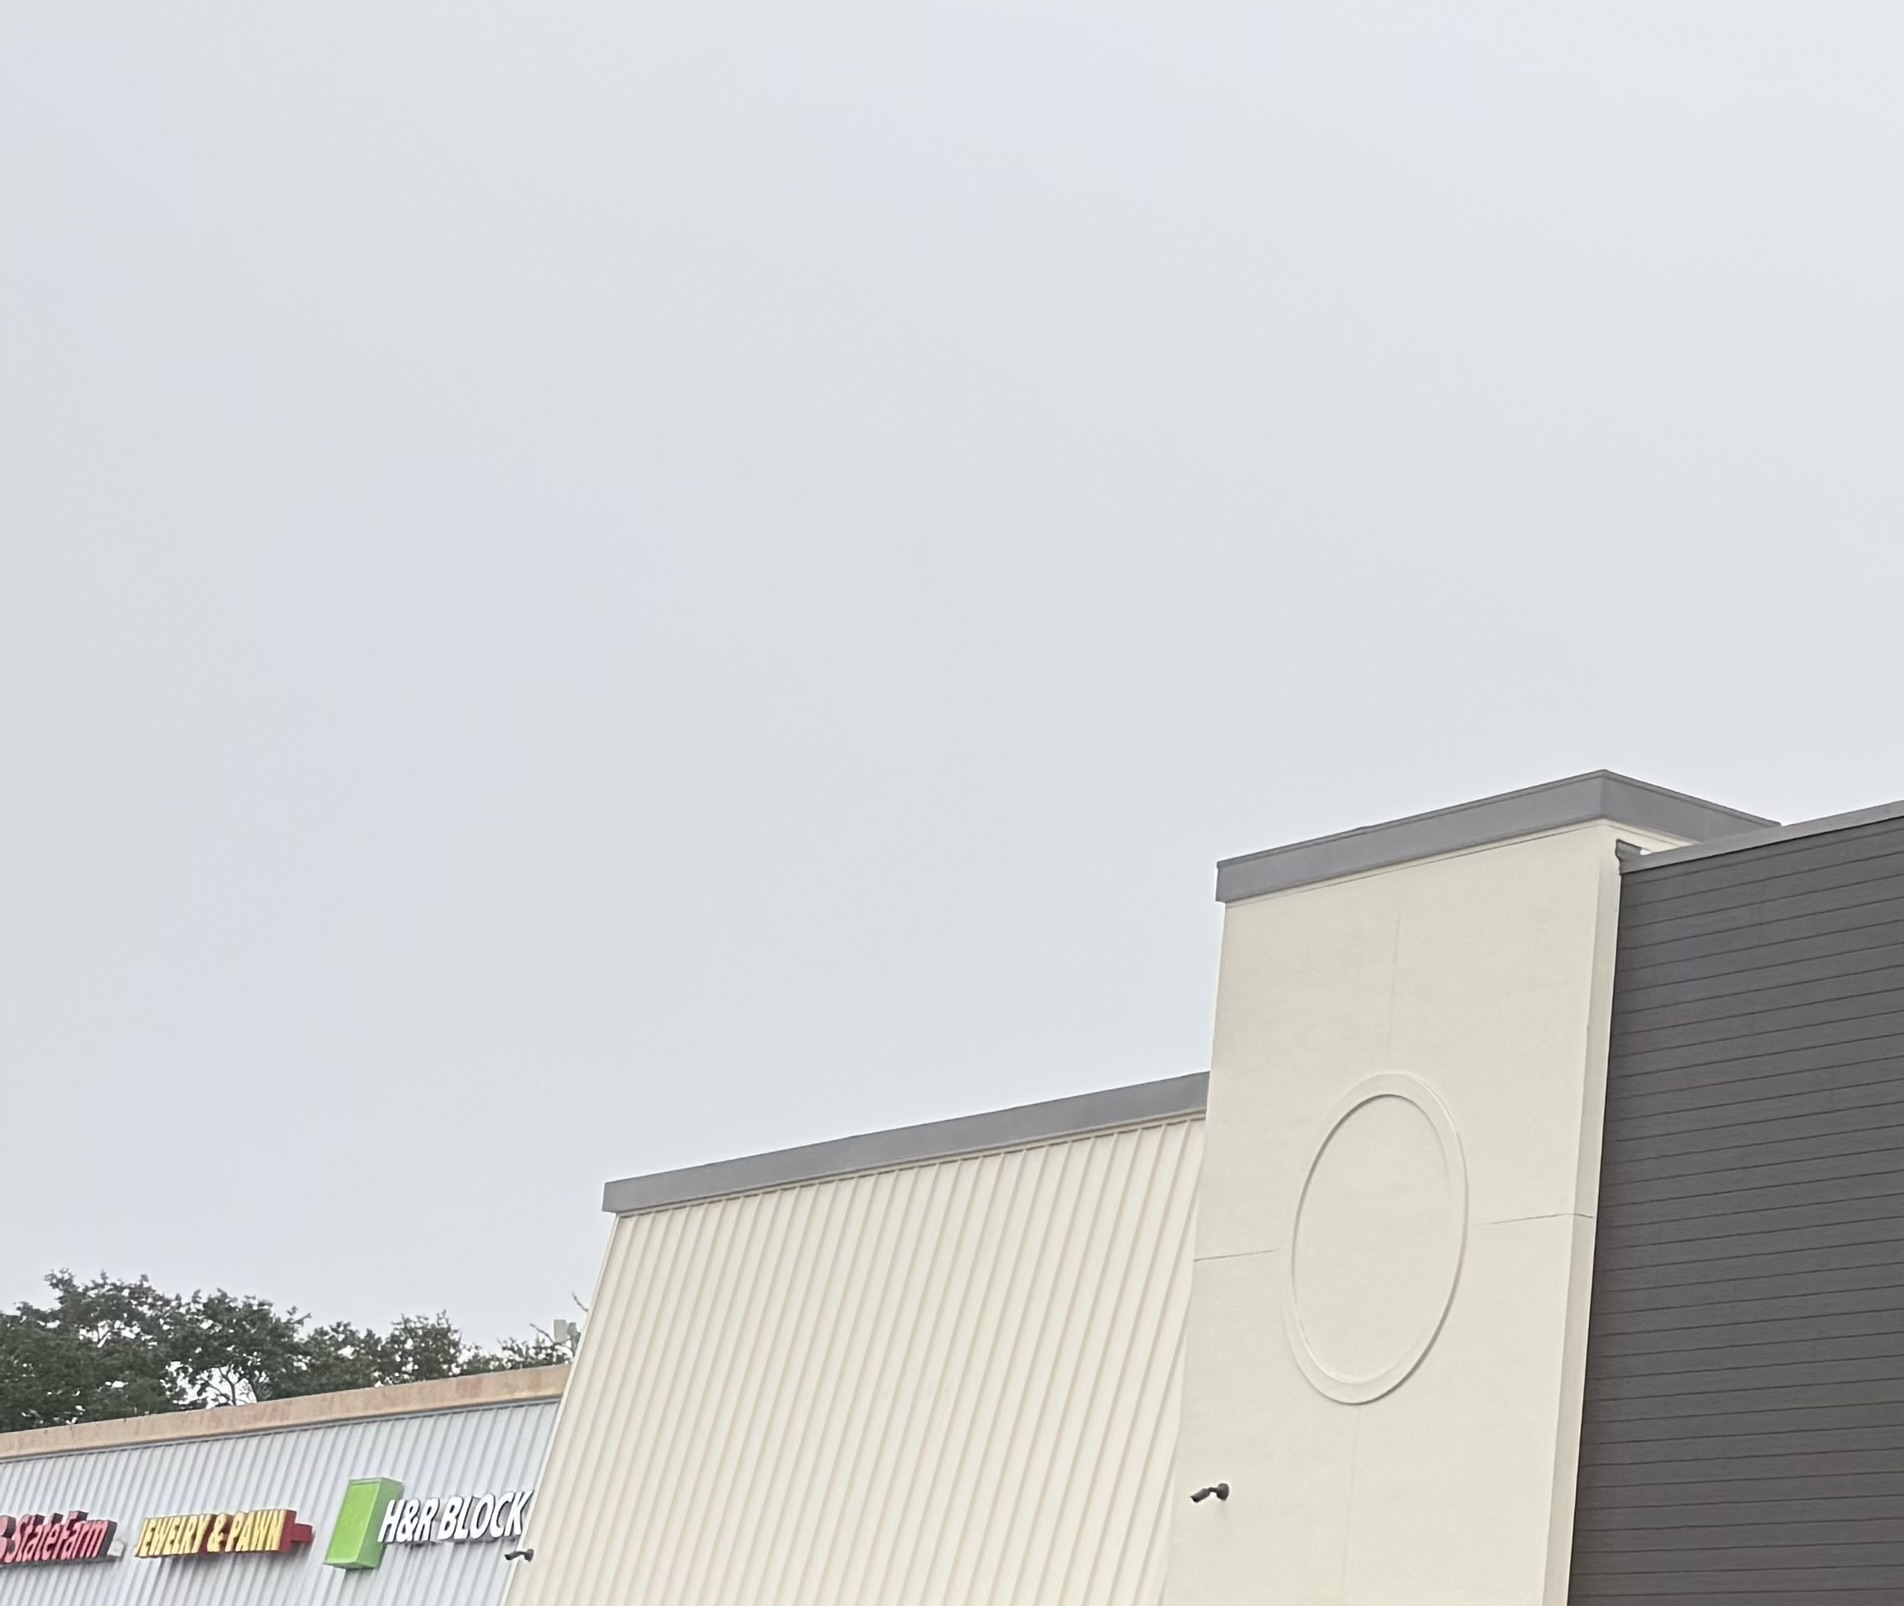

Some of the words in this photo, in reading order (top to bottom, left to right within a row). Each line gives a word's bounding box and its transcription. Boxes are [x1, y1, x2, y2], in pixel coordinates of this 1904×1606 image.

[134, 1514, 212, 1557] JEWELRY
[206, 1513, 227, 1553] &
[225, 1509, 286, 1553] PAWN
[378, 1498, 440, 1543] H&R
[437, 1490, 535, 1540] BLOCK
